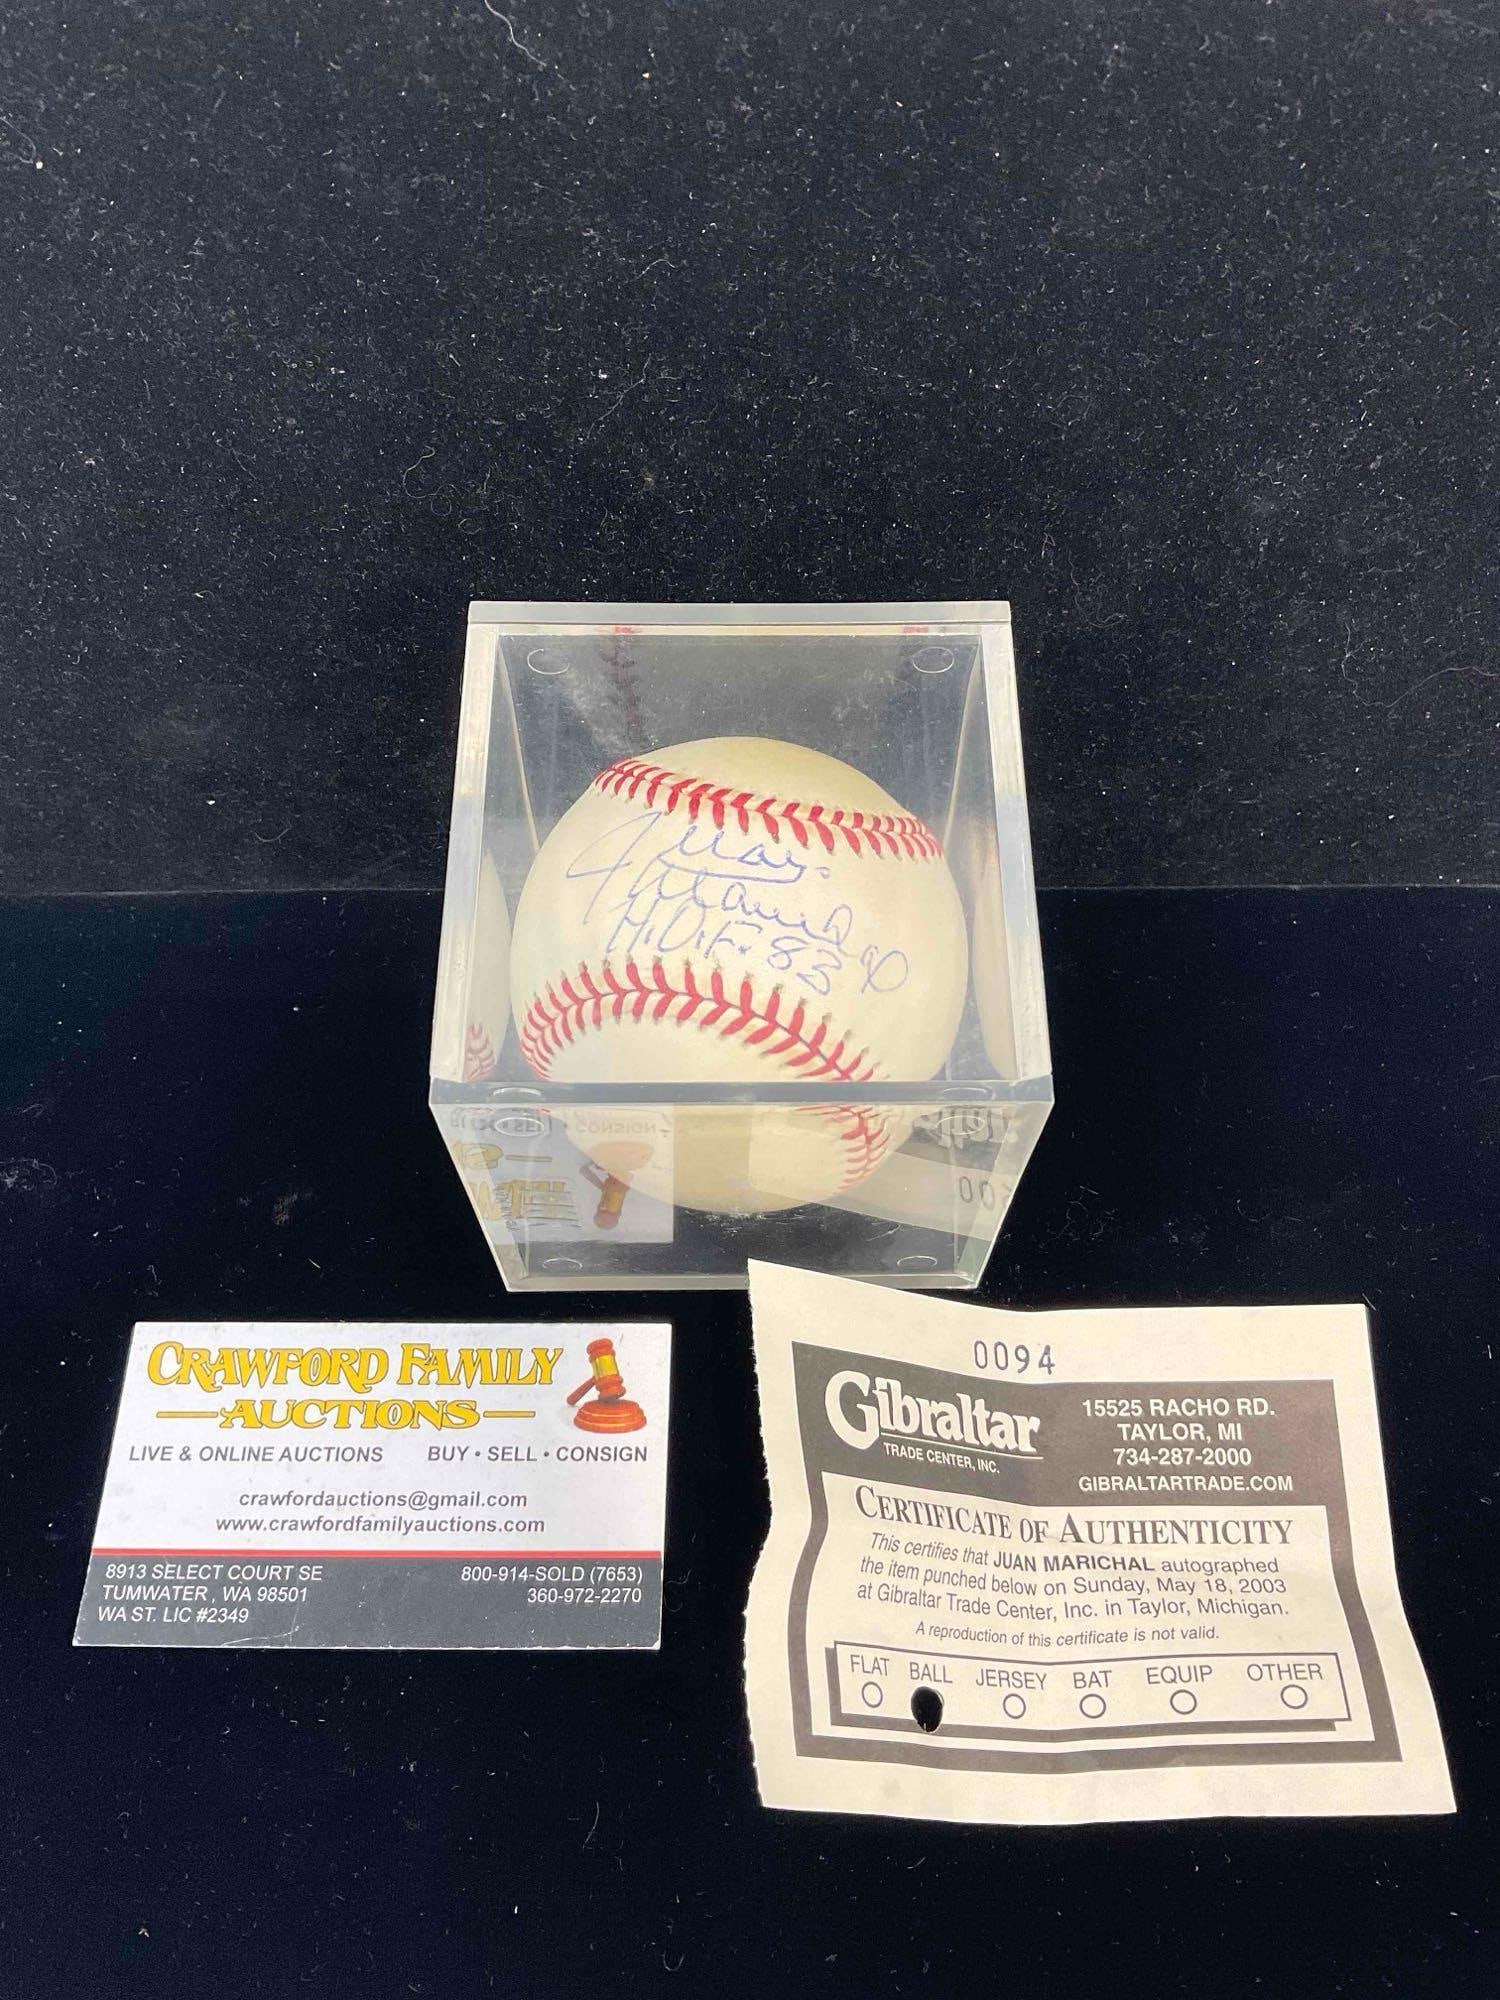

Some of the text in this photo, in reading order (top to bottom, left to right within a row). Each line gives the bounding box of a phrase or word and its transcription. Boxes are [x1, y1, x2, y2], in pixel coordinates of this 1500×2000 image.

[147, 1341, 563, 1394] CRAWFORD FAMILY
[973, 1340, 1056, 1375] 0094
[219, 1399, 480, 1430] AUCTIONS
[825, 1370, 1041, 1452] Gibraltar
[1082, 1398, 1275, 1417] 15525 RACHO RD.
[1117, 1423, 1242, 1443] TAYLOR, MI
[129, 1446, 384, 1462] LIVE & ONLINE AUCTIONS
[427, 1446, 648, 1462] BUY SELL CONSIGN
[883, 1442, 1000, 1474] TRADE CENTER, INC.
[1113, 1448, 1252, 1466] 734-287-2000
[1078, 1475, 1293, 1492] GIBRALTARTRADE.COM
[239, 1490, 528, 1511] crawfordauctions@gmail.com
[216, 1516, 545, 1533] www.crawfordfamilyauctions.com
[855, 1485, 1293, 1545] CERTIFICATE OF AUTHENTICITY
[870, 1532, 1279, 1576] This certifies that JUAN MARICHAL autographed
[105, 1564, 323, 1581] 8913 SELECT COURT SE
[461, 1566, 643, 1584] 800-914-SOLD (7653)
[860, 1556, 1287, 1596] the item punched below on Sunday, May 18, 2003
[223, 1587, 252, 1602] WA
[257, 1586, 308, 1602] 98501
[527, 1587, 642, 1603] 360-972-2270
[857, 1583, 1289, 1622] at Gibraltar Trade Center, Inc. in Taylor, Michigan.
[97, 1607, 249, 1623] WA ST. LIC #2349
[915, 1621, 1220, 1647] A reproduction of this certificate is not valid.
[850, 1655, 1323, 1690] FLAT BALL JERSEY BAT EQUIP OTHER
